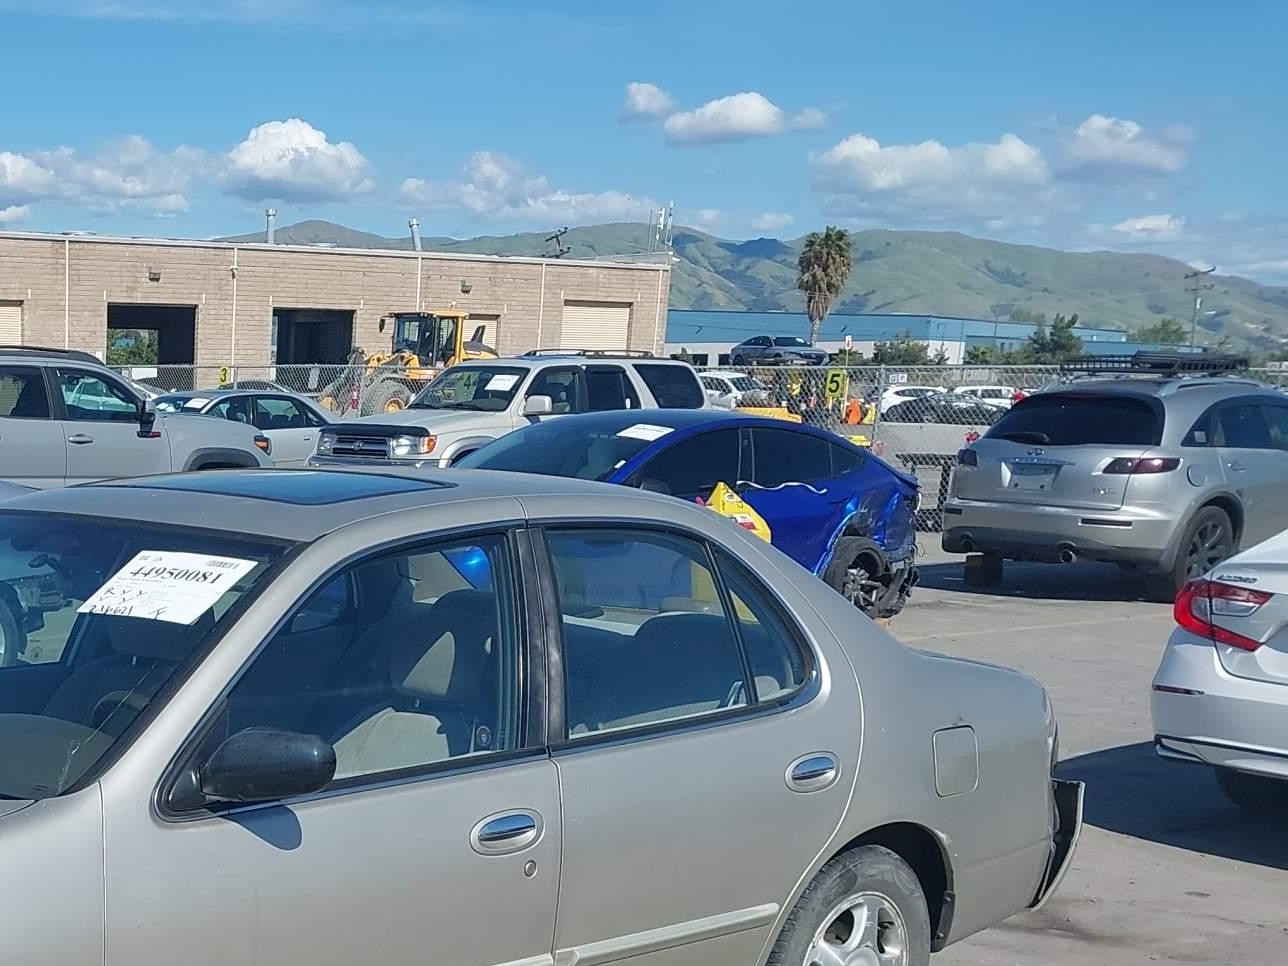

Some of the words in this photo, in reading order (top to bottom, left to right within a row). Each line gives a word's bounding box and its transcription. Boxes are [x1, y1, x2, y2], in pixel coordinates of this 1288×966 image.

[220, 368, 227, 382] 3
[463, 374, 472, 390] 4
[827, 373, 841, 393] 5
[130, 566, 223, 584] 44950081
